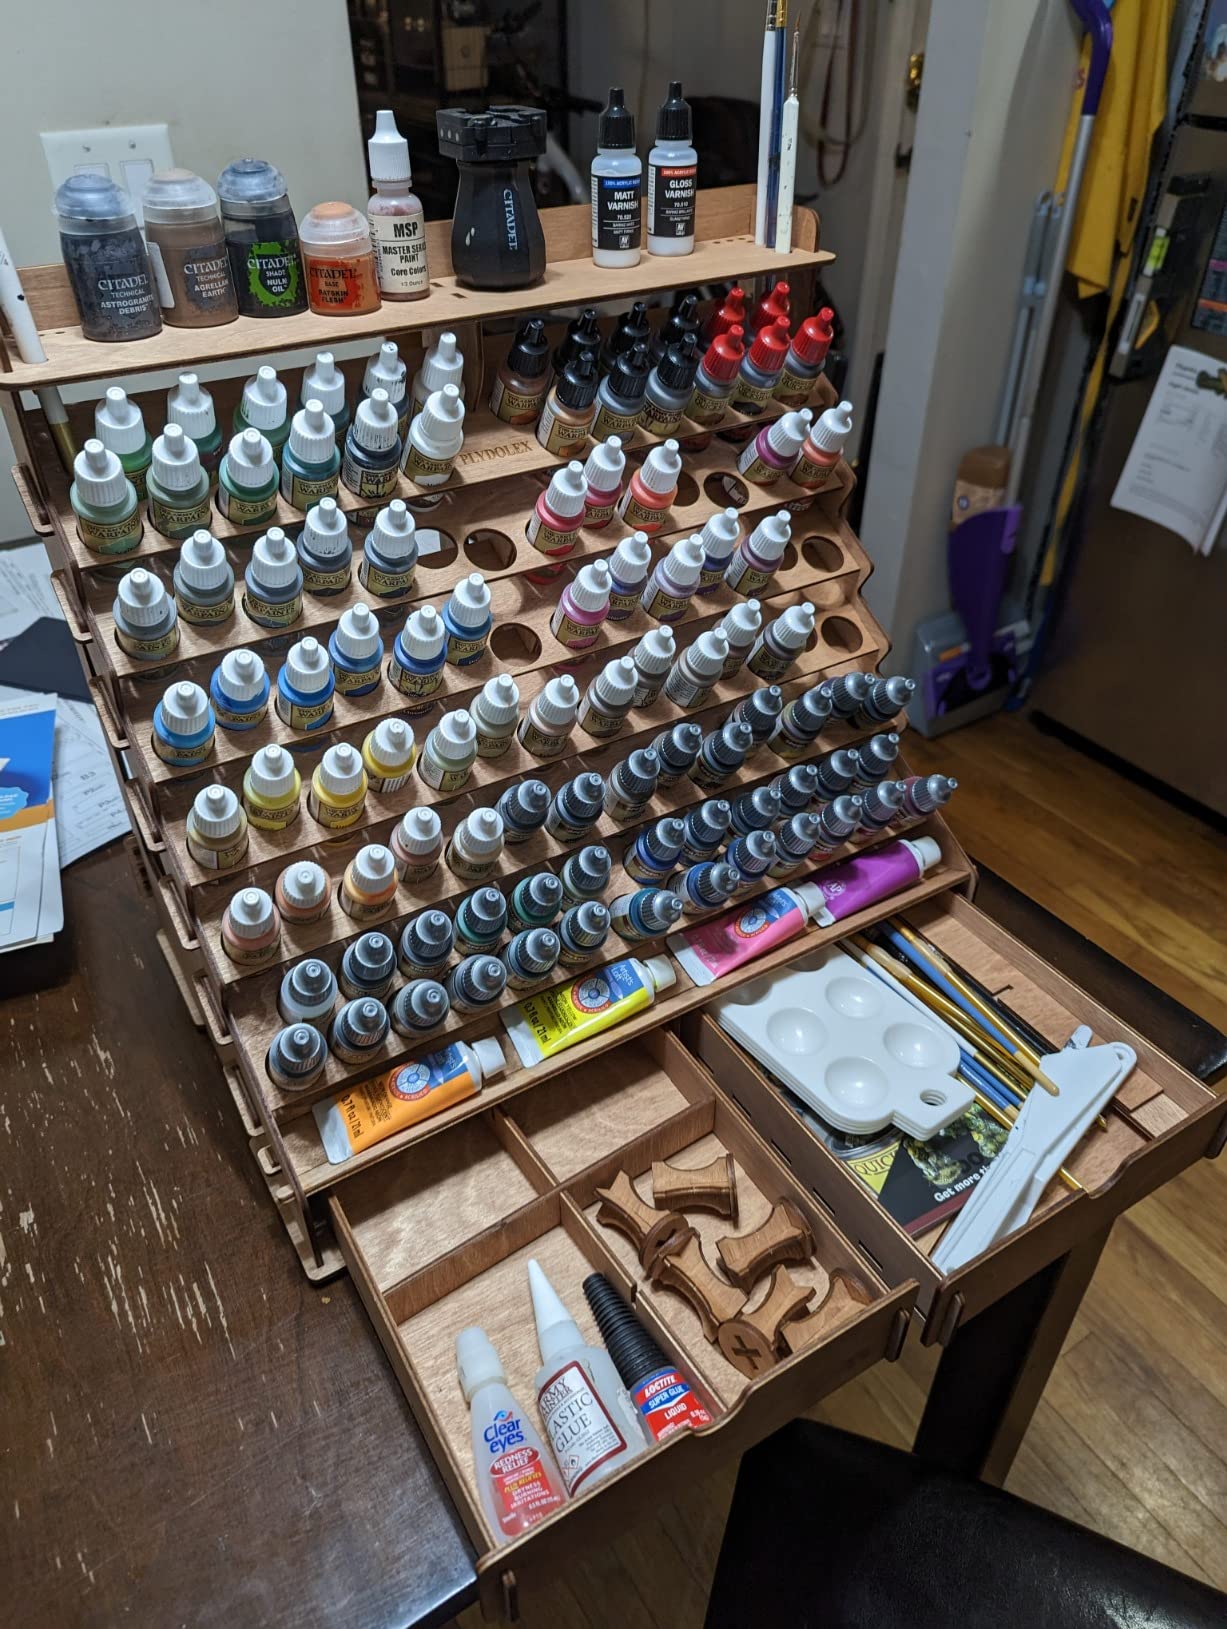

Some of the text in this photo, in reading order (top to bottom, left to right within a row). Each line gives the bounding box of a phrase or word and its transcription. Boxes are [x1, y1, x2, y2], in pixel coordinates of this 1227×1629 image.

[669, 179, 693, 188] GLOSS
[614, 191, 635, 200] MATT
[664, 188, 695, 198] VARNISH
[607, 201, 639, 211] VARNISH
[503, 188, 518, 250] CITADEL
[393, 221, 418, 238] MSP
[382, 245, 411, 255] MASTER
[184, 256, 228, 275] CITADEL
[247, 255, 294, 270] CITADEL
[399, 253, 419, 264] PAINT
[196, 271, 226, 282] TECHNICAL
[265, 269, 286, 277] SHADE
[310, 267, 354, 279] CITADEL
[390, 265, 427, 276] Core Colors
[98, 273, 149, 291] CITADEL
[194, 278, 229, 292] AGRELLAN
[267, 277, 288, 286] NULN
[110, 288, 145, 299] TECHNICAL
[201, 287, 226, 298] EARTH
[272, 285, 285, 293] OIL
[118, 304, 148, 315] DEBRIS
[459, 441, 533, 465] PLYDOLEX
[611, 967, 623, 981] Loft
[619, 964, 634, 986] Artist's
[933, 1187, 956, 1203] Get
[953, 1173, 982, 1194] more
[644, 1374, 676, 1399] LOCTITE
[648, 1384, 685, 1409] SUPER GLUE
[664, 1402, 688, 1420] LIQUID
[483, 1419, 521, 1443] Clear
[555, 1413, 593, 1453] GLUE
[489, 1430, 525, 1454] eyes
[494, 1447, 533, 1470] REDNESS
[501, 1456, 529, 1474] RELIEF
